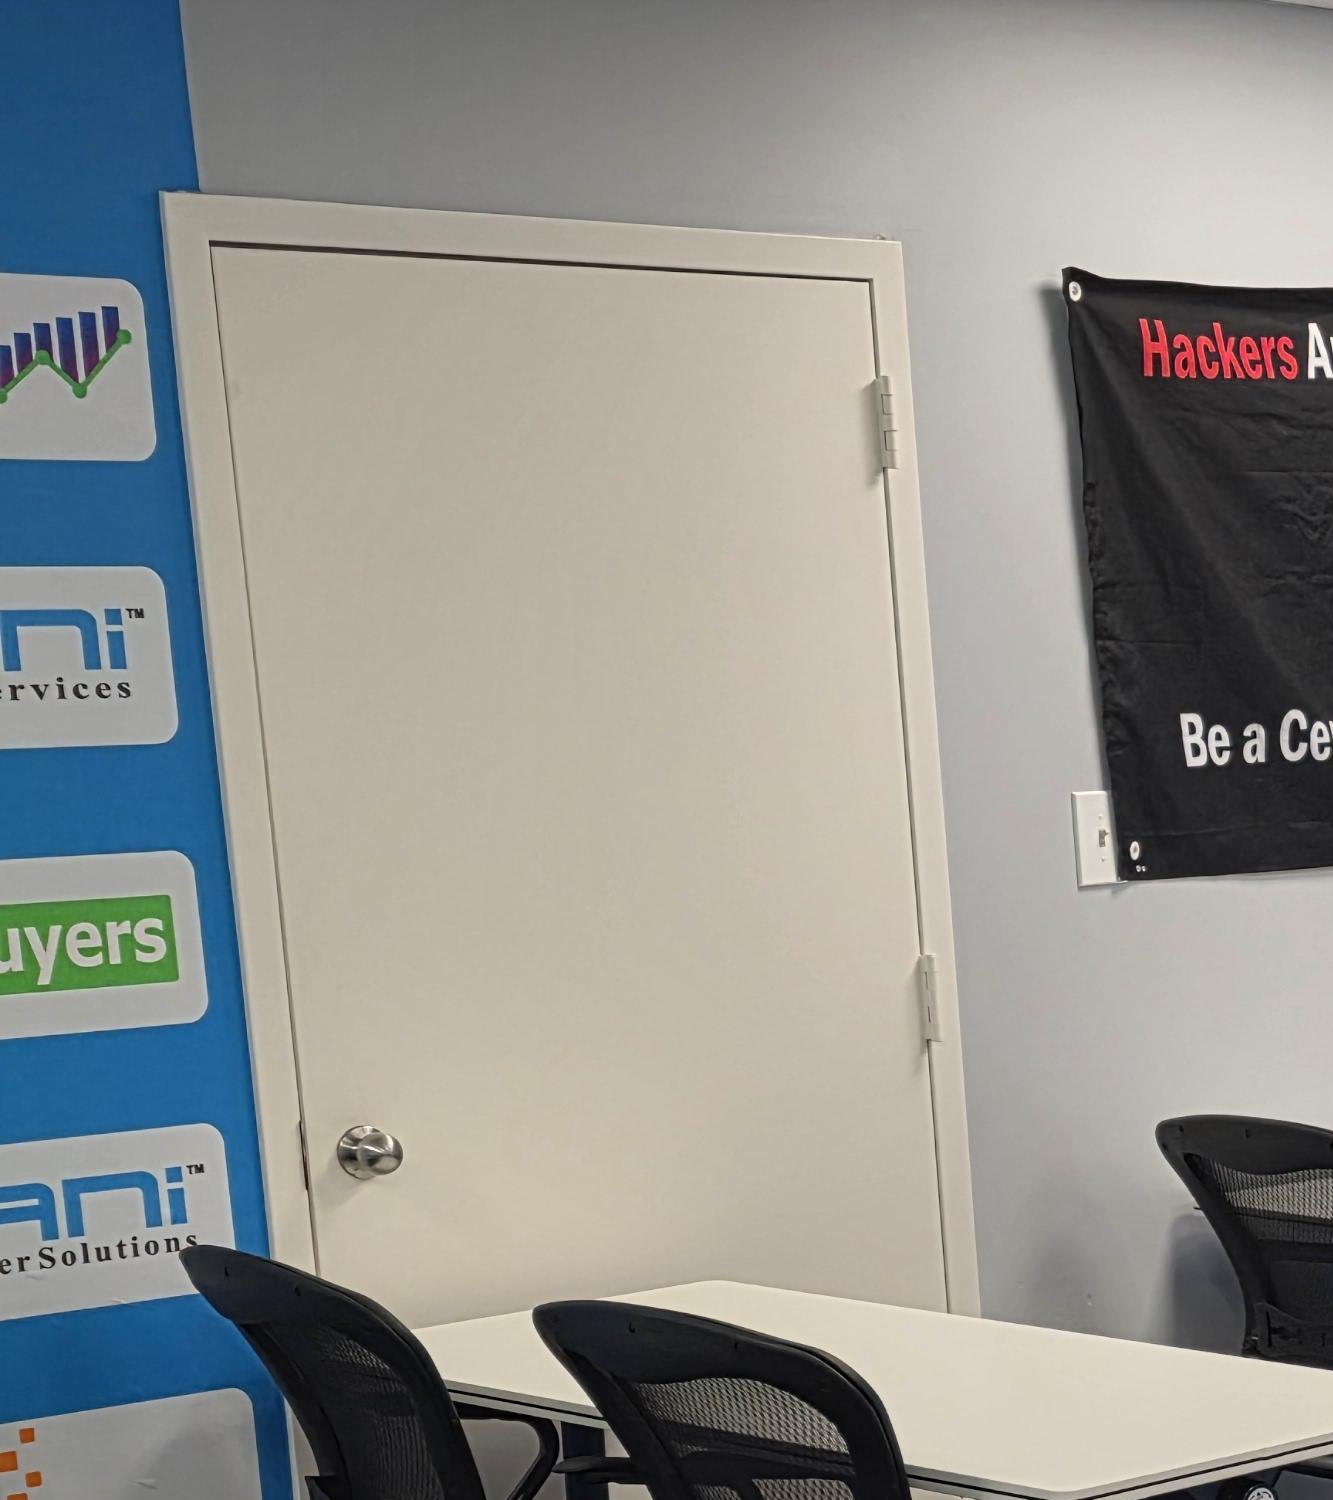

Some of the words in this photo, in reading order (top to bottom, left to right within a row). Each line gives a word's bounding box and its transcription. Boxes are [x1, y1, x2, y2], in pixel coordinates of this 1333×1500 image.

[1138, 317, 1300, 381] Hackers
[0, 676, 132, 701] rvices
[1179, 712, 1231, 768] Be
[1242, 722, 1266, 764] a
[38, 1232, 198, 1271] Solutions
